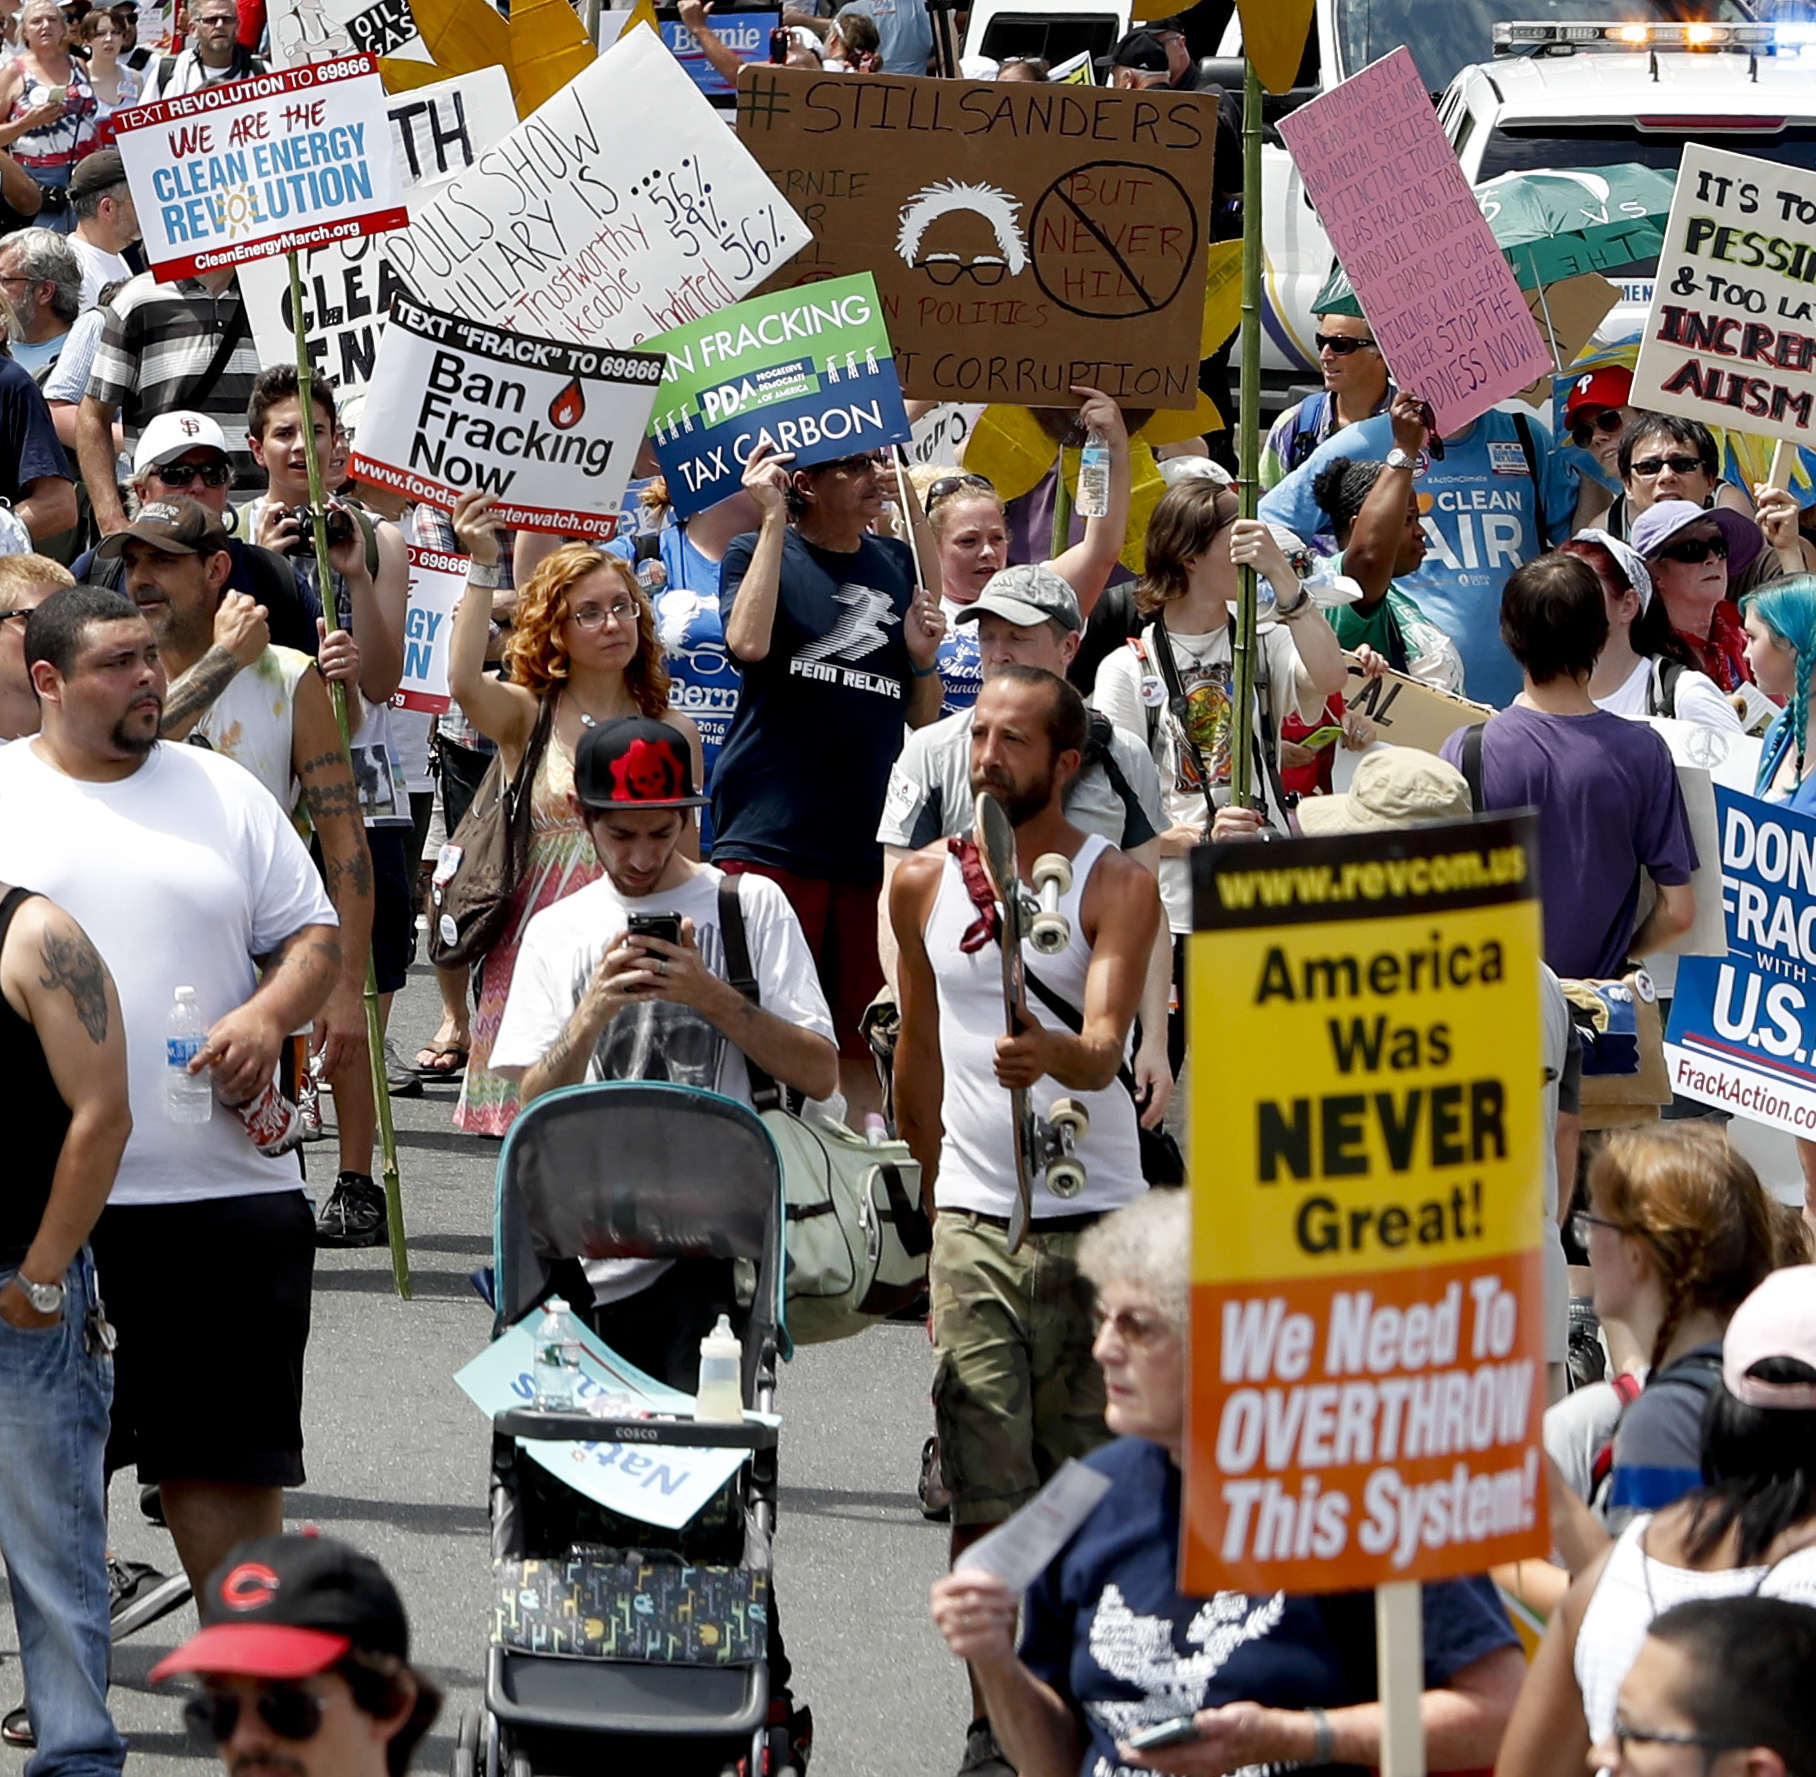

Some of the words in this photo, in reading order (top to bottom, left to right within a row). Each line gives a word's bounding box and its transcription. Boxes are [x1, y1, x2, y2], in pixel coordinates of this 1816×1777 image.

[117, 104, 165, 129] TEXT
[168, 77, 285, 116] REVOLUTION
[287, 69, 313, 88] TO
[317, 57, 369, 81] 69866
[153, 145, 246, 203] CLEAN
[253, 122, 365, 177] ENERGY
[169, 122, 215, 159] WE
[229, 111, 270, 147] ARE
[279, 99, 327, 132] THE
[195, 221, 360, 269] CleanEnergyMarch.org
[397, 299, 452, 339] TEXT
[567, 350, 597, 373] TO
[600, 355, 662, 381] 69866
[699, 295, 870, 367] FRACKING
[427, 350, 526, 413] Ban
[409, 430, 517, 498] Now
[418, 391, 614, 476] Fracking
[678, 445, 730, 492] TAX
[733, 400, 883, 465] CARBON
[1437, 490, 1521, 510] CLEAN
[842, 674, 901, 699] RELAYS
[1217, 846, 1526, 909] www.revcom.us
[1254, 936, 1505, 1006] America
[1329, 1018, 1451, 1075] Was
[1258, 1080, 1507, 1182] NEVER
[1296, 1184, 1484, 1255] Great!
[1221, 1300, 1314, 1382] We
[1326, 1289, 1453, 1377] Need
[1469, 1276, 1518, 1356] To
[615, 1427, 660, 1440] COSCO
[1215, 1359, 1532, 1477] OVERTHROW
[1220, 1479, 1349, 1563] This
[1365, 1454, 1538, 1570] System!
